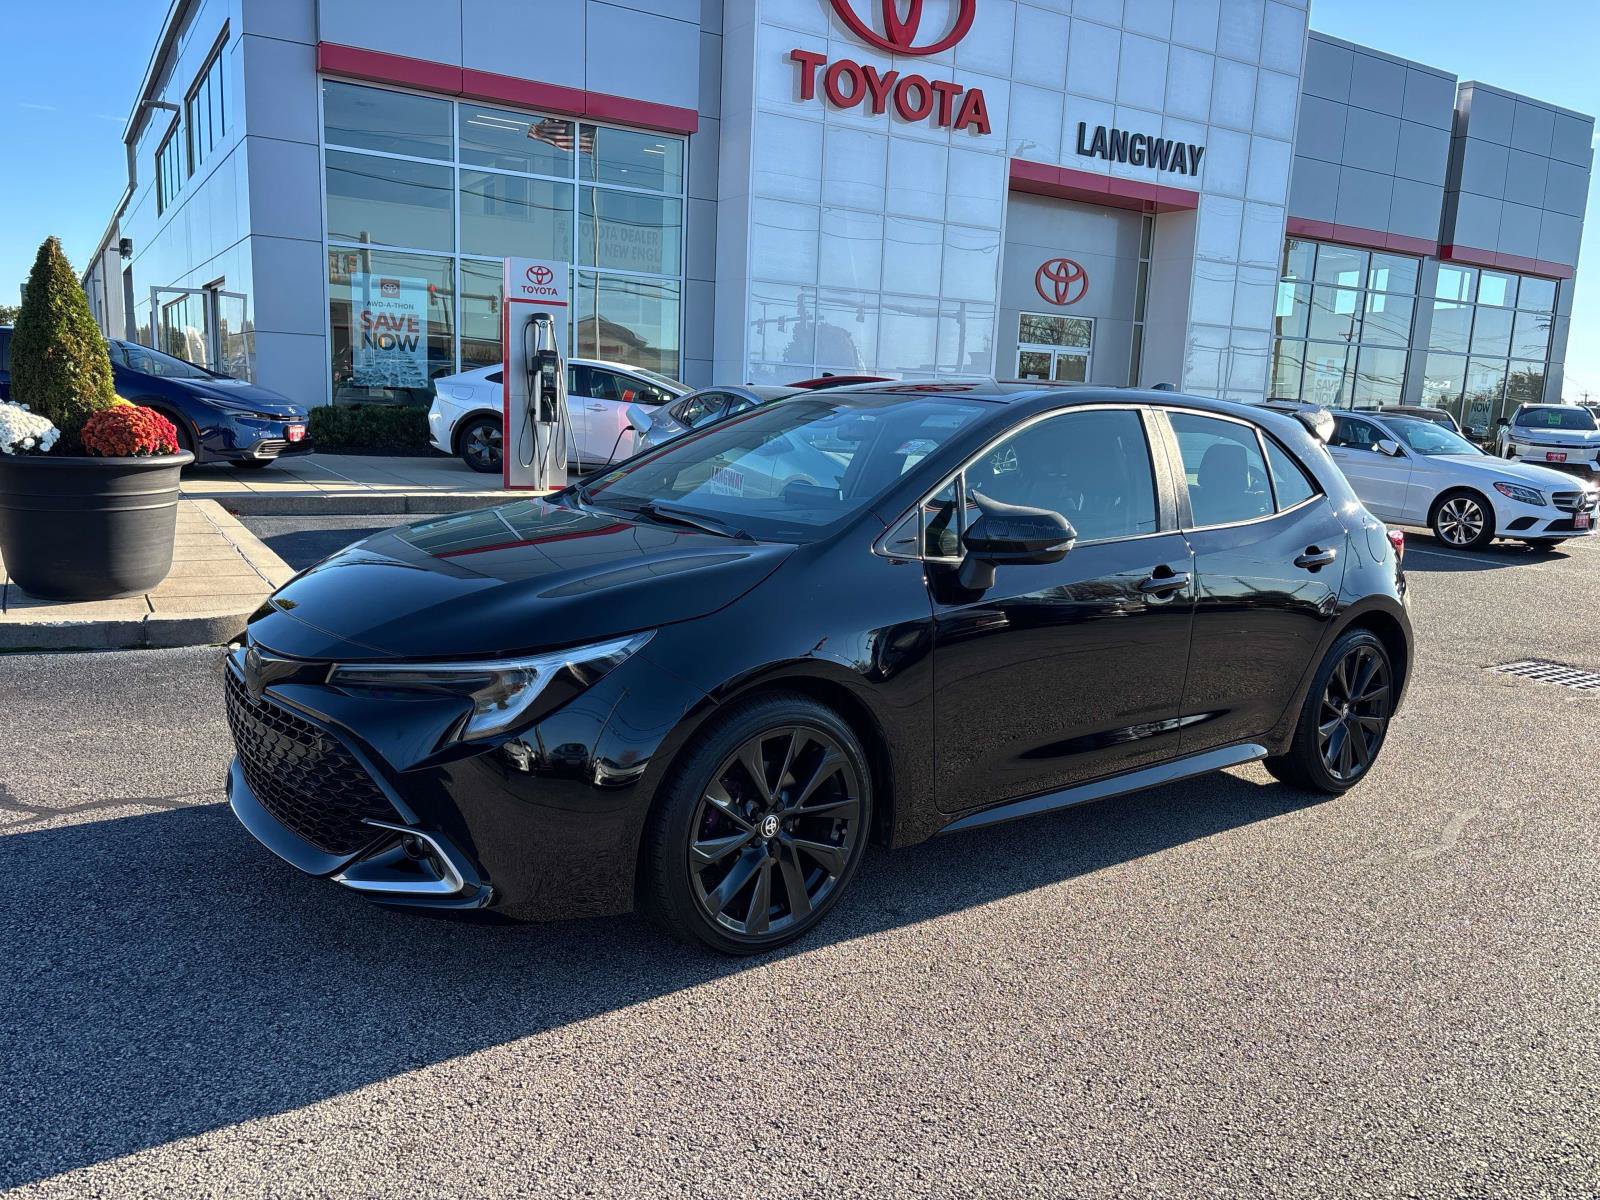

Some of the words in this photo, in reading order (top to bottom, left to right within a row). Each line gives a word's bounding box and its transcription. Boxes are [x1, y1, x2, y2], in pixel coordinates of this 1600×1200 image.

[790, 49, 991, 134] TOYOTA
[1077, 121, 1204, 176] LANGWAY
[521, 285, 558, 296] TOYOTA
[366, 300, 415, 311] AWD-A-THON
[361, 310, 420, 333] SAVE
[361, 332, 420, 352] NOW
[1471, 402, 1491, 413] NOW
[711, 466, 744, 491] LANGWAY
